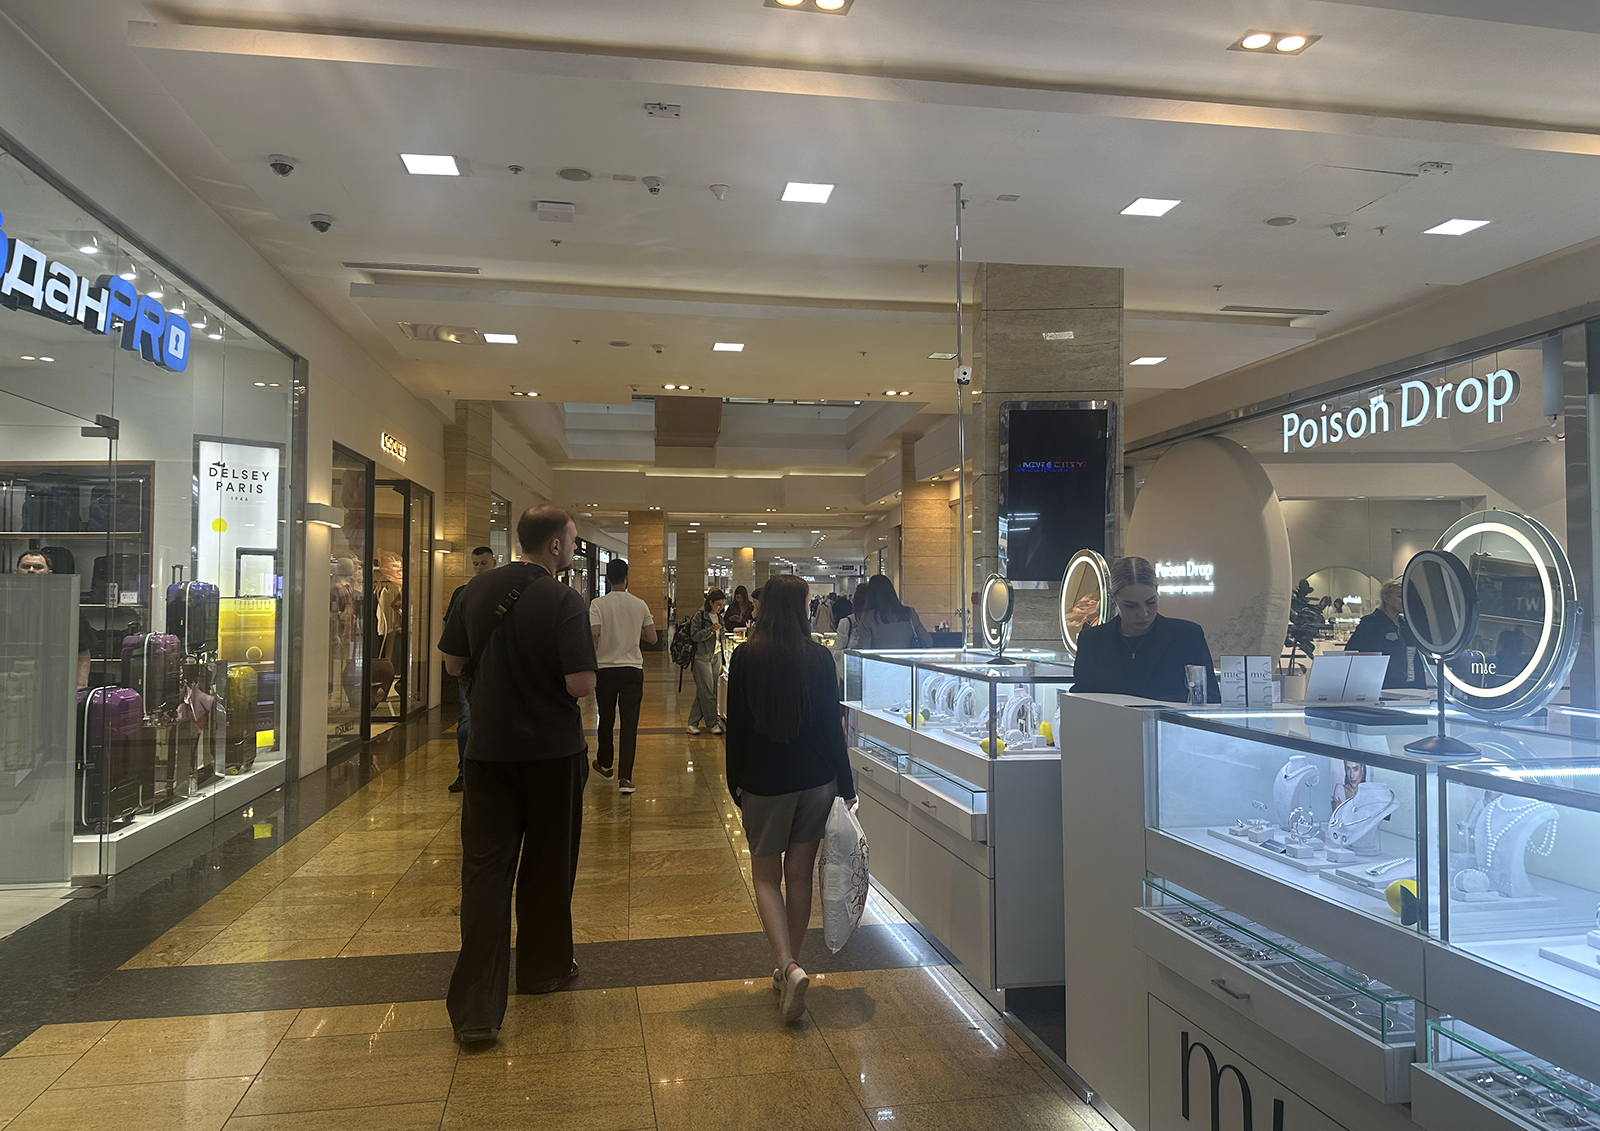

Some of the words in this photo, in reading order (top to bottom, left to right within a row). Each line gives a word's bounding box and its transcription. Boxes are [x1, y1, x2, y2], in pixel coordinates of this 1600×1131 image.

[1282, 399, 1389, 453] Poison
[1401, 369, 1514, 428] Drop
[209, 467, 270, 481] DELSEY
[216, 481, 263, 494] PARIS
[1155, 562, 1186, 577] Poison
[1186, 560, 1214, 580] Drop
